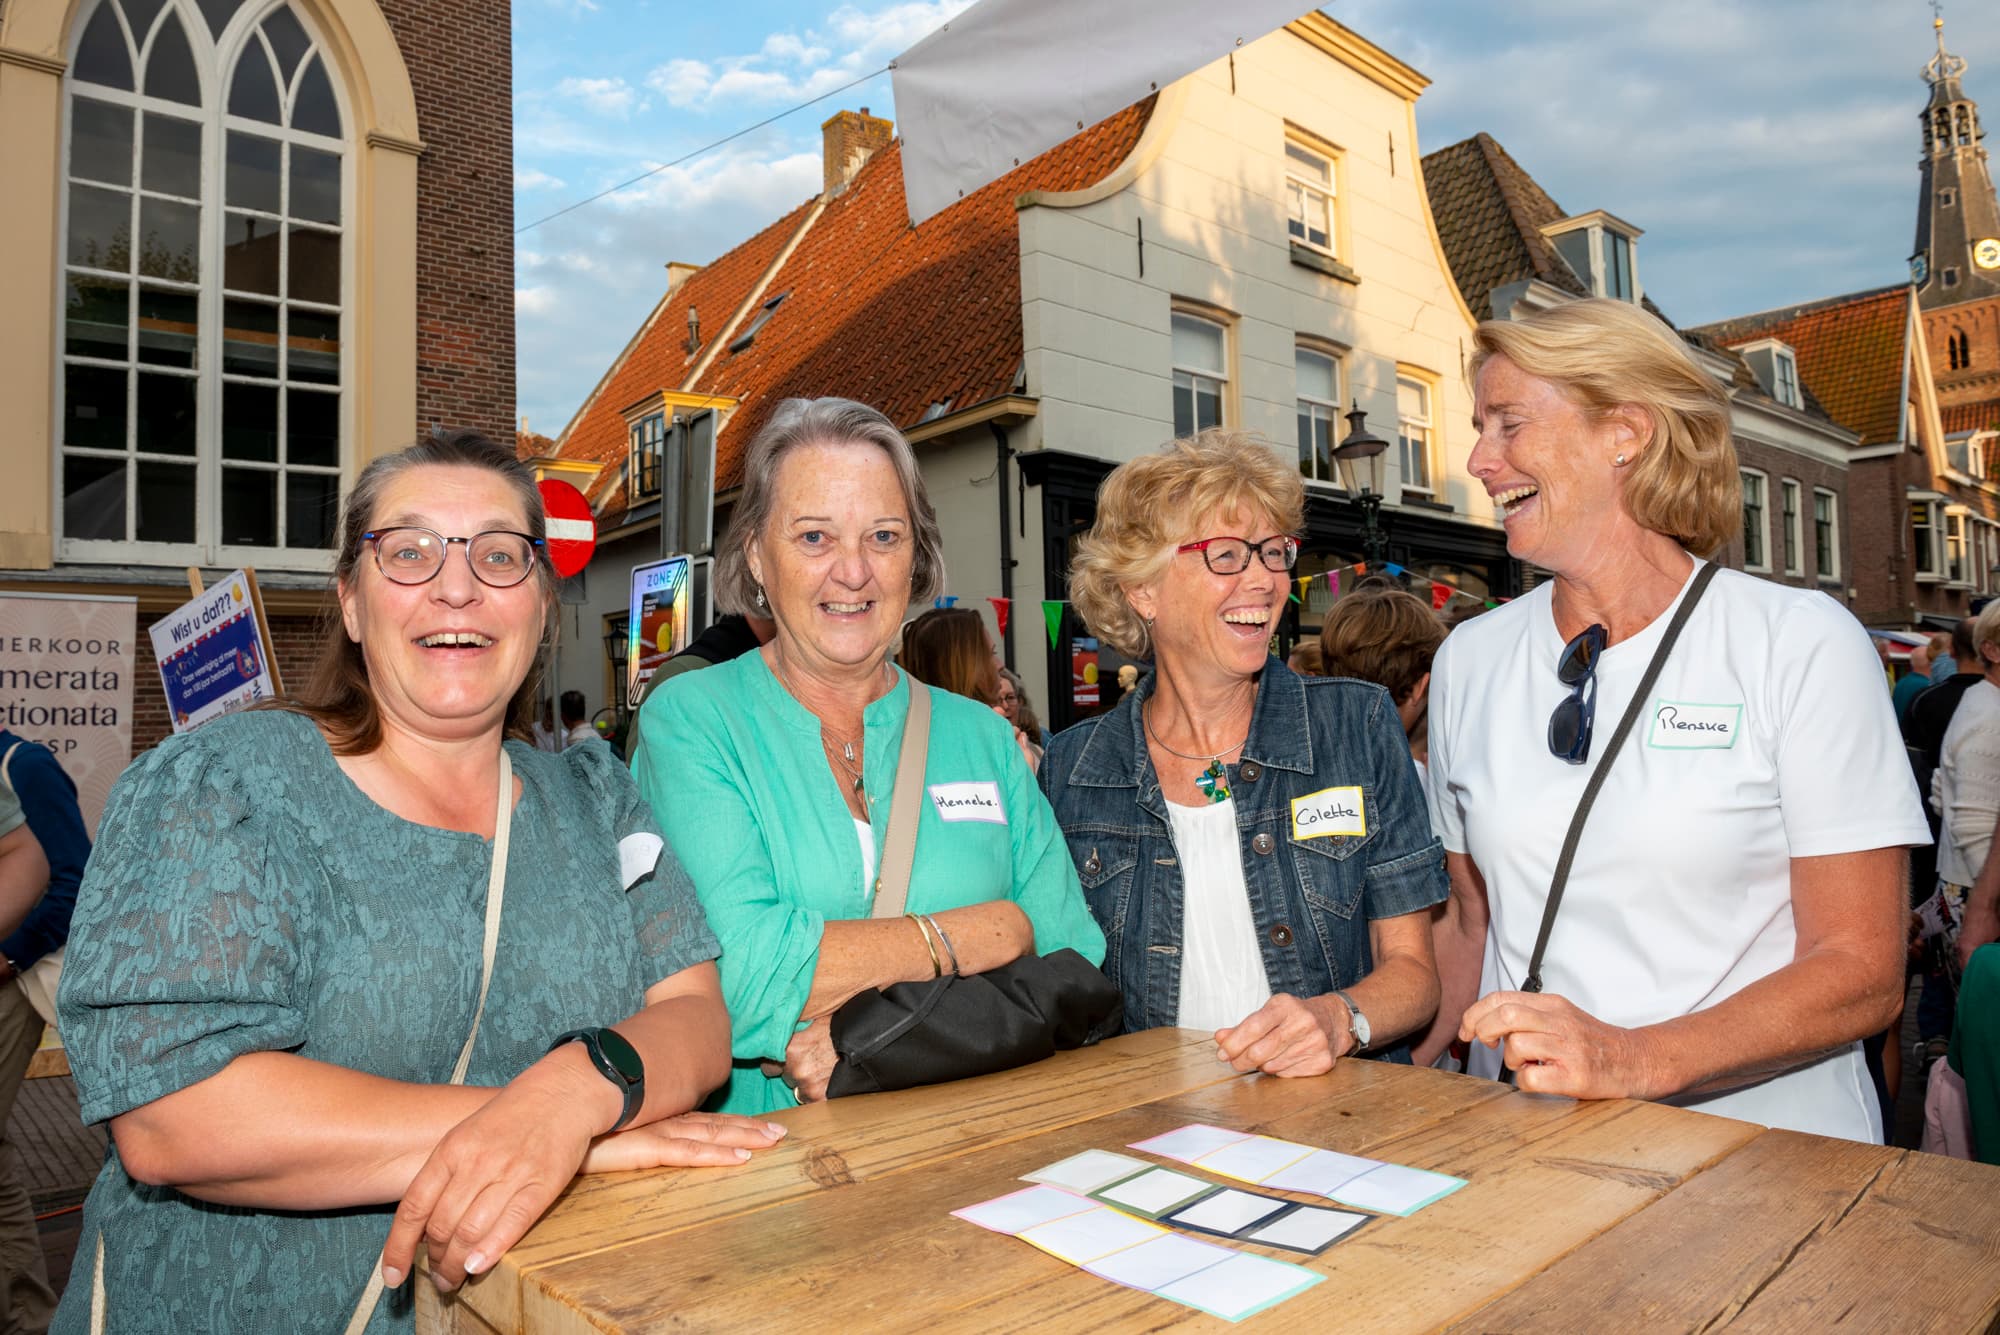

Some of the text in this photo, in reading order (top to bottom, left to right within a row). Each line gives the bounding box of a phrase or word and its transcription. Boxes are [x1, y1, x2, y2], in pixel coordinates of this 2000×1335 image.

[647, 570, 673, 588] ZONE
[171, 592, 232, 644] Wist u dat??
[1657, 706, 1729, 732] Renske
[1296, 803, 1359, 825] Colette
